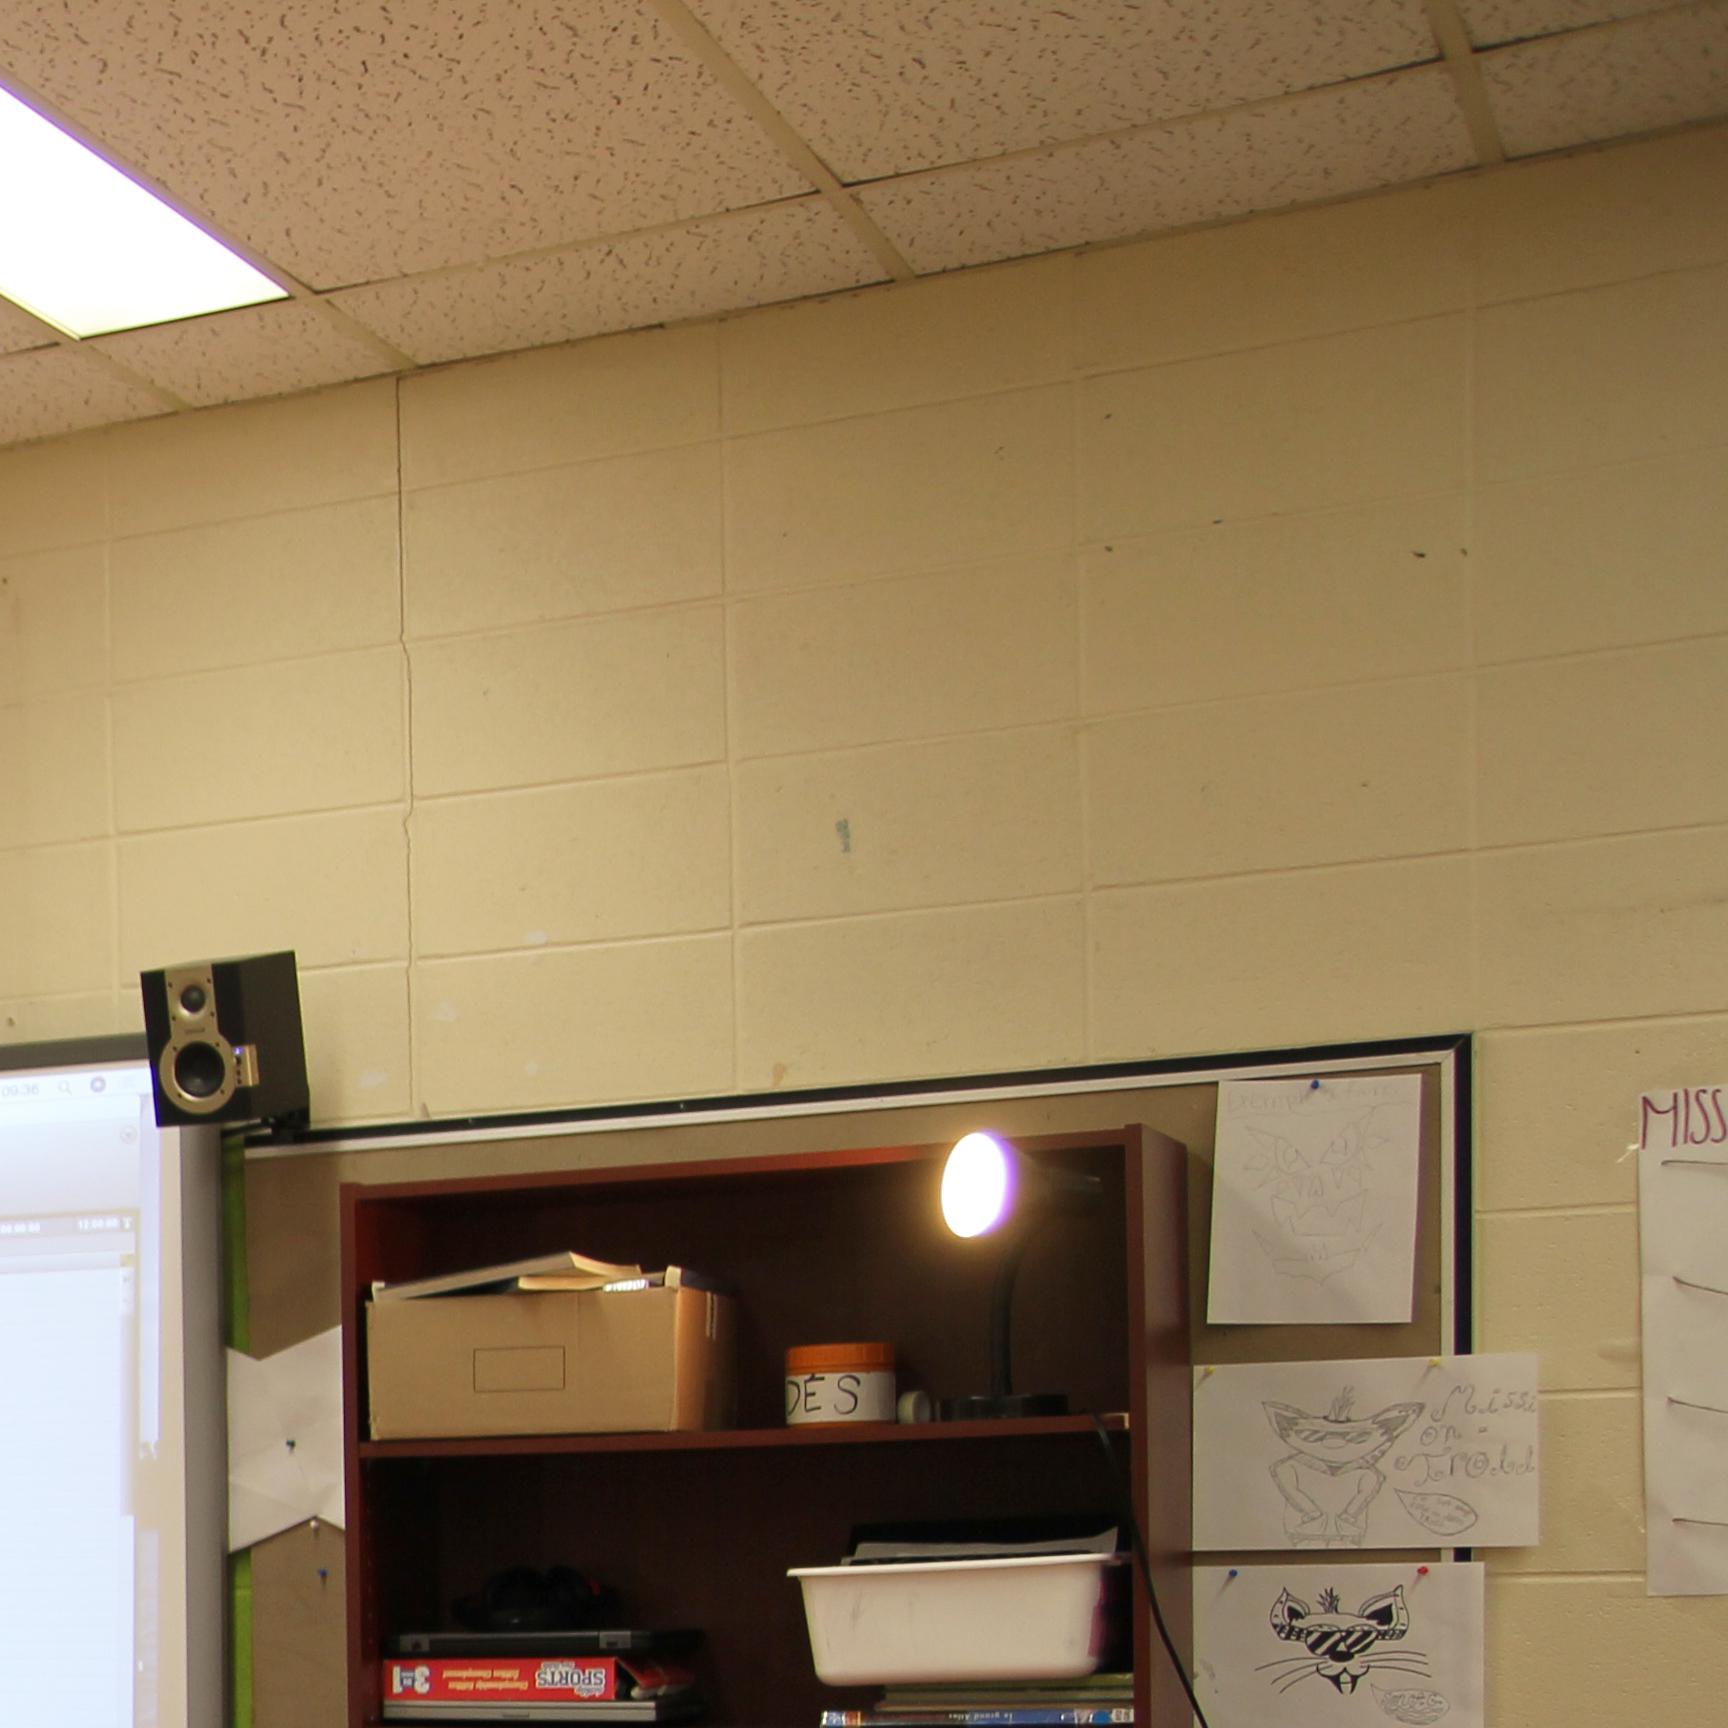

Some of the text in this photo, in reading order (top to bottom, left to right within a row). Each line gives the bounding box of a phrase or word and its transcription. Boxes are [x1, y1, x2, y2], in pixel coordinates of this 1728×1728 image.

[392, 1664, 403, 1694] 1
[413, 1664, 430, 1695] 3
[537, 1669, 605, 1687] SPORTS
